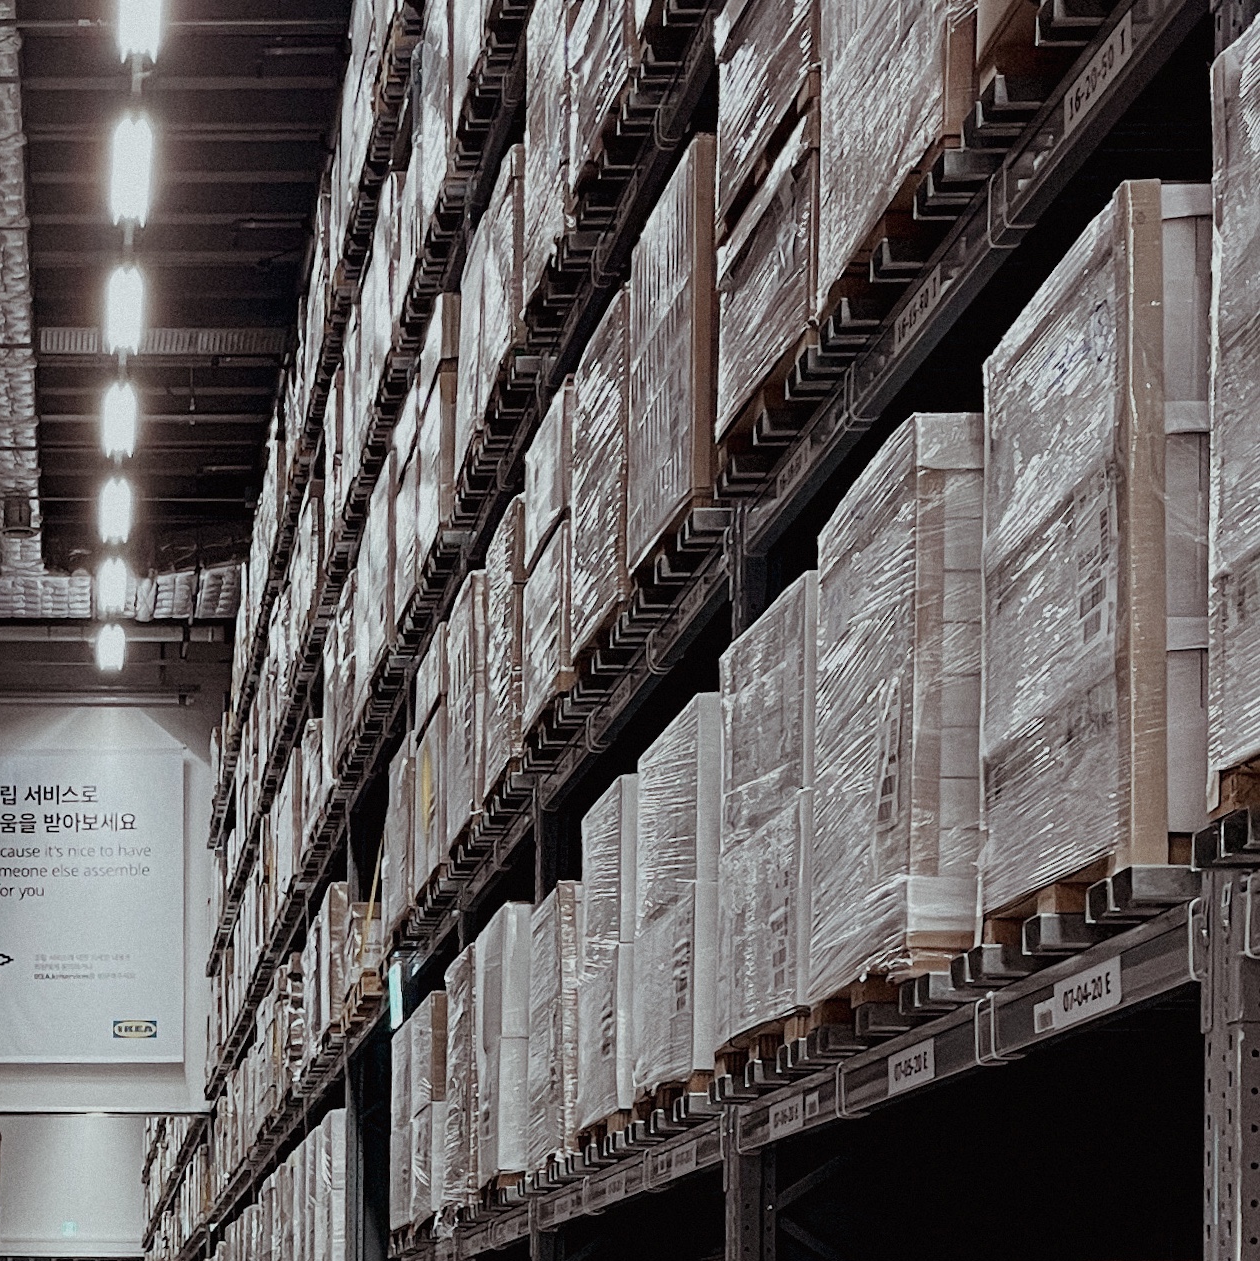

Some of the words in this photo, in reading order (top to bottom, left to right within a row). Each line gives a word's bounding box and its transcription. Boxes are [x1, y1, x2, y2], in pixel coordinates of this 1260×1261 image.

[1069, 43, 1115, 121] 16-20-50
[24, 785, 99, 805] 서비스로
[43, 812, 138, 834] 받아보세요
[44, 845, 64, 857] it's
[68, 846, 96, 857] nice
[100, 846, 114, 857] to
[118, 844, 152, 857] have
[52, 864, 79, 878] else
[83, 864, 150, 878] assemble
[19, 887, 45, 900] you
[1063, 975, 1103, 1012] 07-04-20
[1105, 971, 1111, 995] E
[116, 1024, 154, 1034] IKEA
